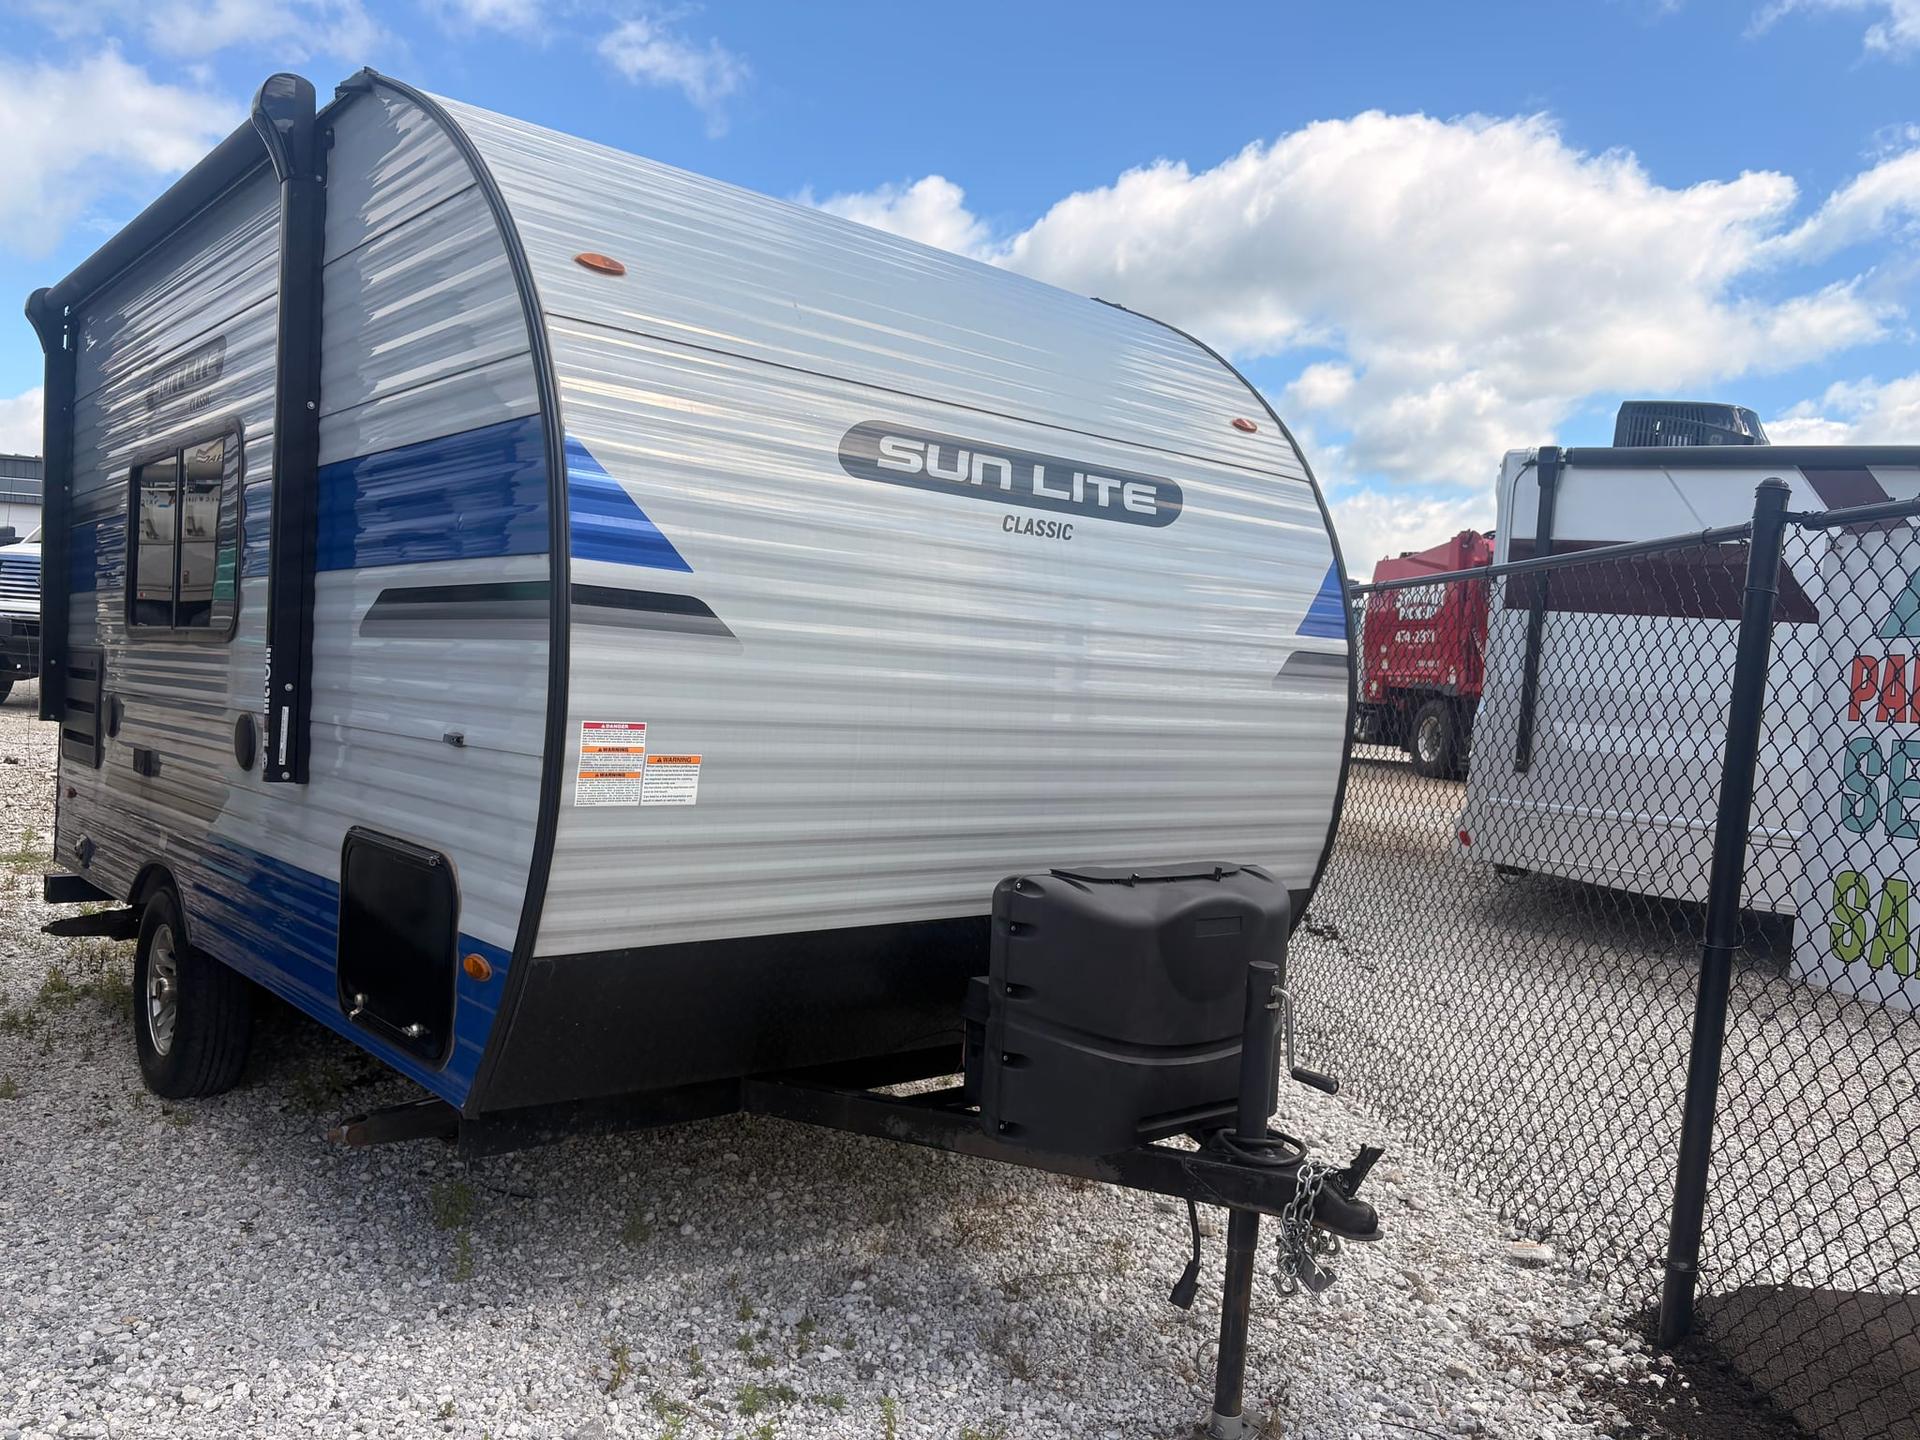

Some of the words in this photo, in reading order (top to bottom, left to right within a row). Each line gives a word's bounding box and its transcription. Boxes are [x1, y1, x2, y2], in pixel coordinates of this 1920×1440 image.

[877, 435, 1012, 491] SUN
[1032, 464, 1157, 516] LITE
[1002, 514, 1074, 541] CLASSIC
[662, 756, 692, 764] WARNING
[1830, 869, 1920, 980] SA
